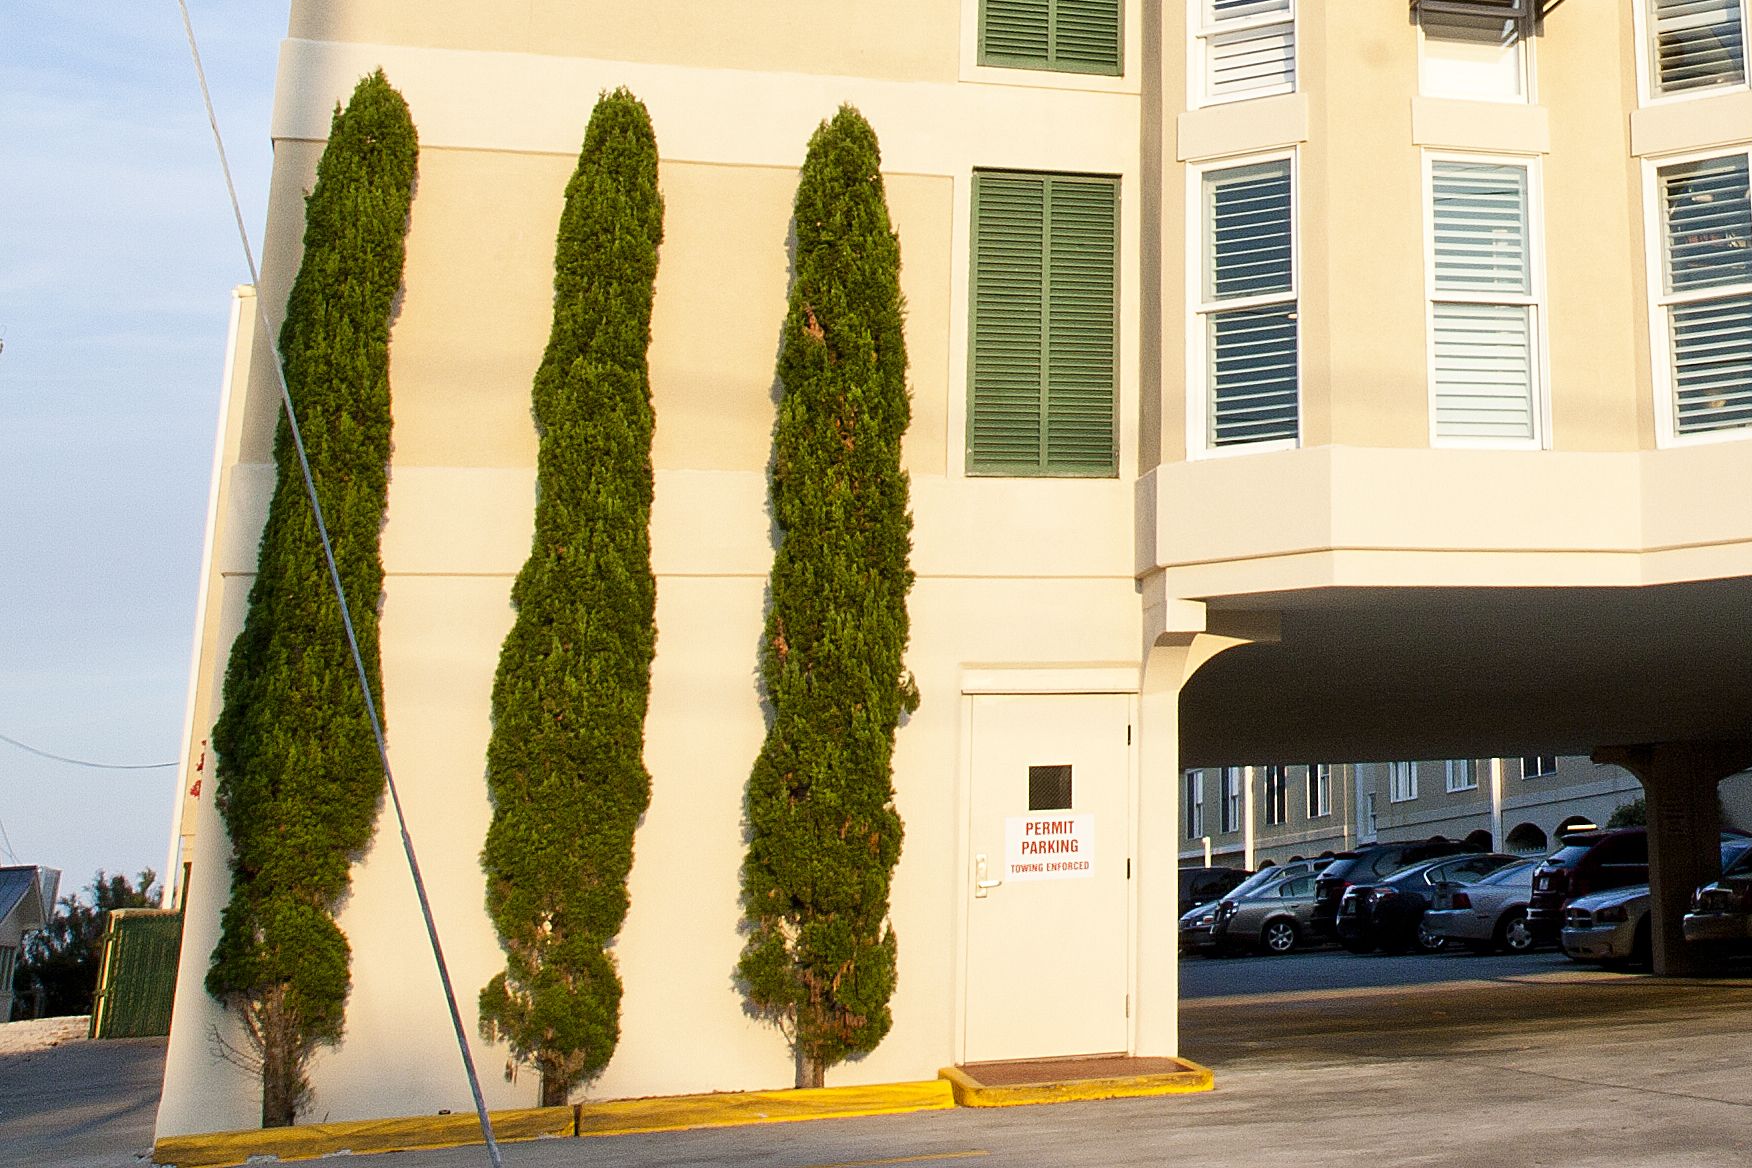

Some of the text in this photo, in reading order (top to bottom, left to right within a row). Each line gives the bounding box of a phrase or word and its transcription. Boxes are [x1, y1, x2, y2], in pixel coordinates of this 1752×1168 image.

[1025, 820, 1075, 836] PERMIT
[1021, 839, 1079, 855] PARKING
[1010, 861, 1090, 873] TOWING ENFORCED
